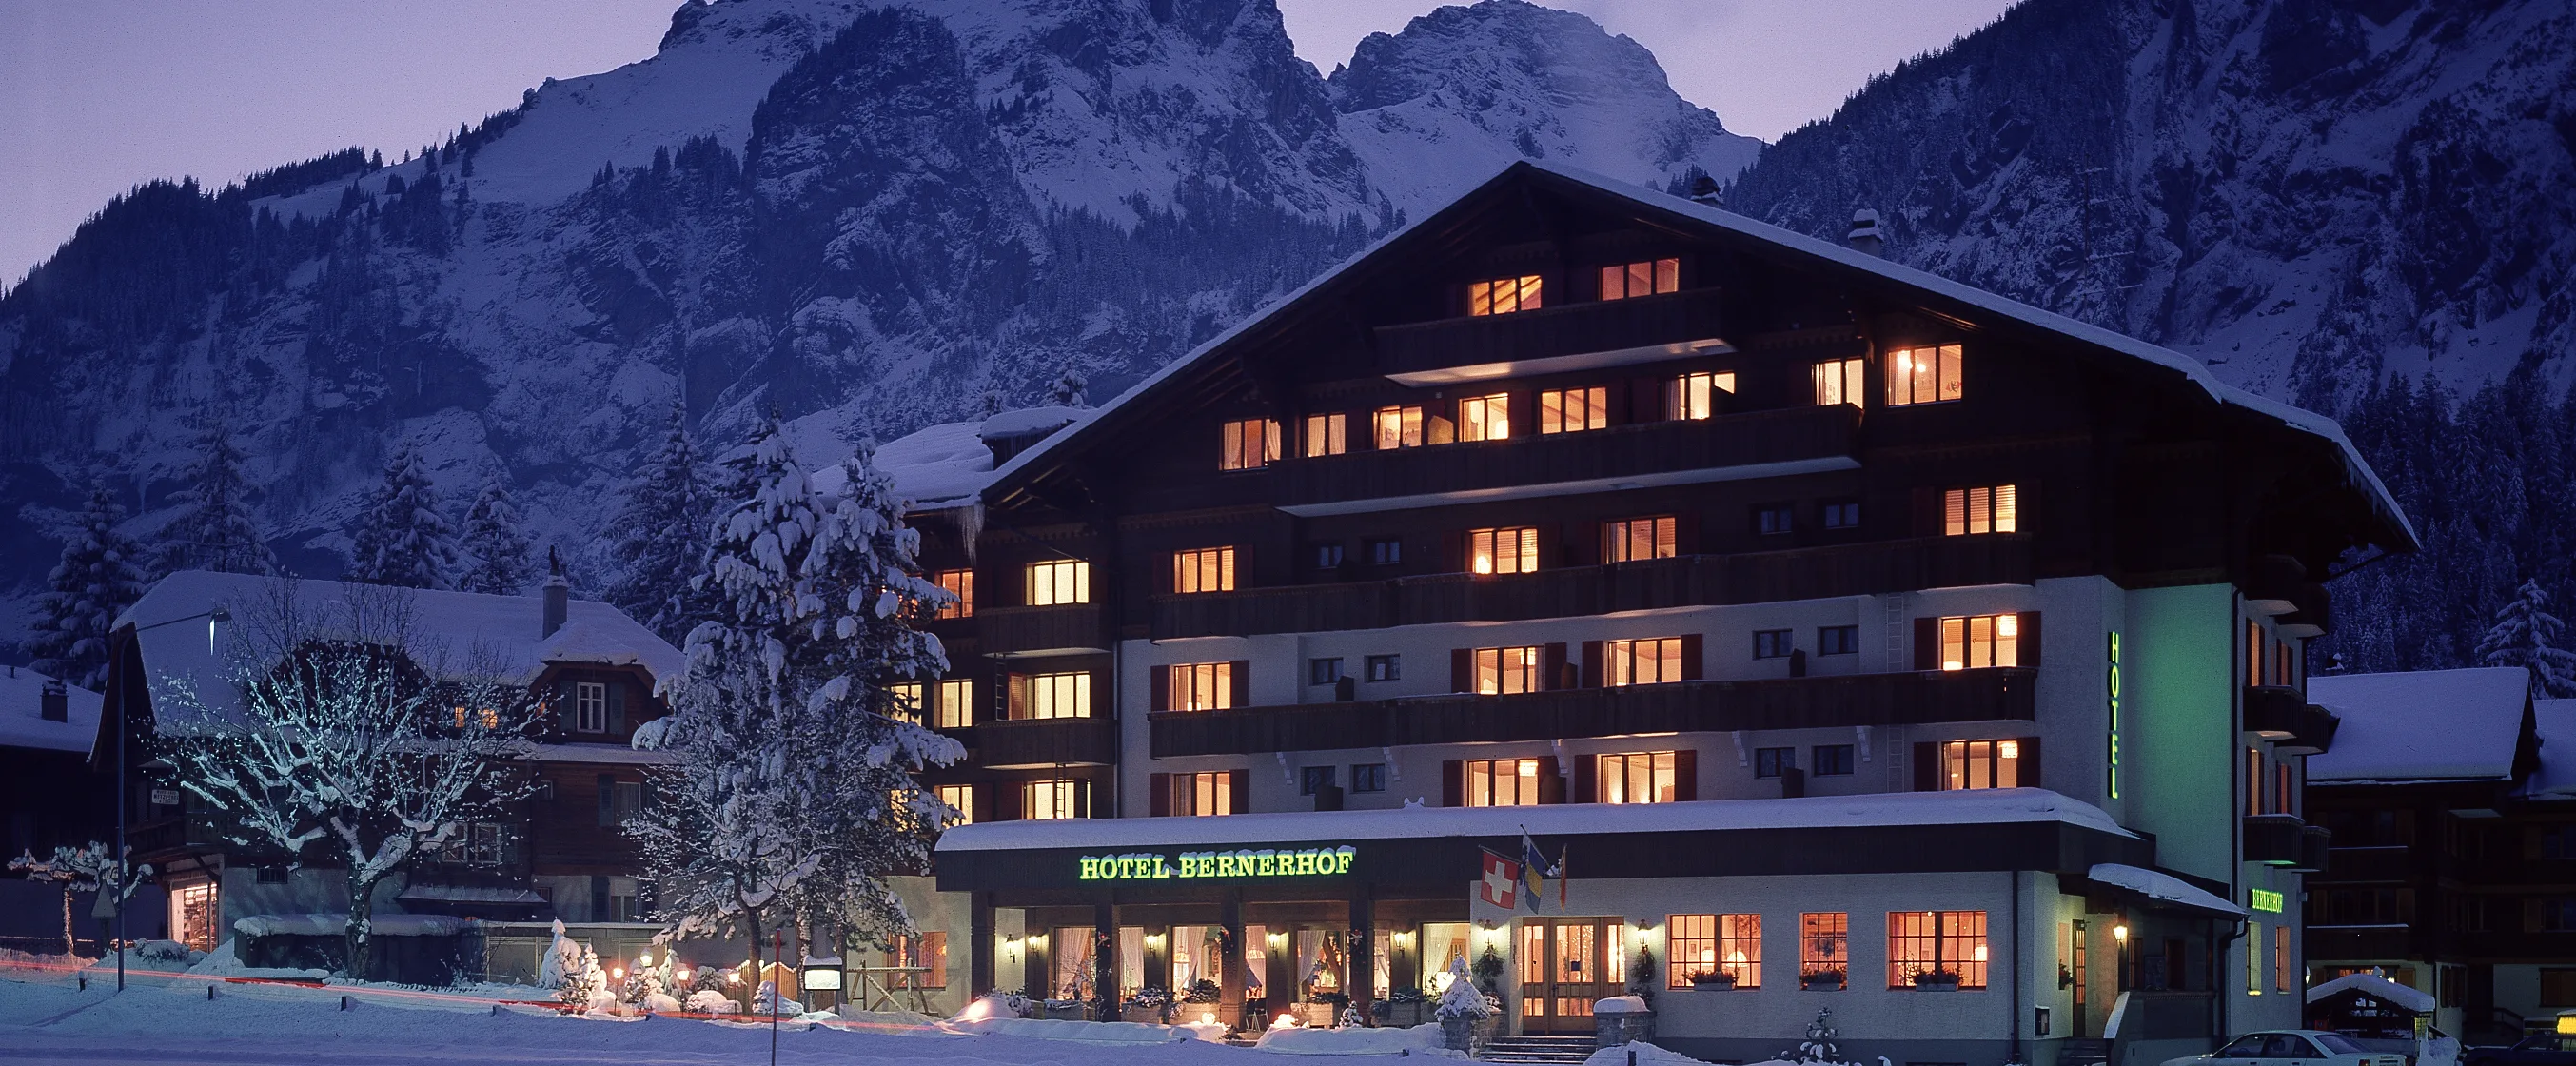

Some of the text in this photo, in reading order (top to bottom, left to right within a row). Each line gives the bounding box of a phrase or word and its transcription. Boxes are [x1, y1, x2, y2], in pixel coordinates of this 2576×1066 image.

[2111, 630, 2120, 800] HOTEL
[1079, 851, 1353, 879] HOTEL BERNERHOF
[2252, 888, 2283, 914] BERNERHOF
